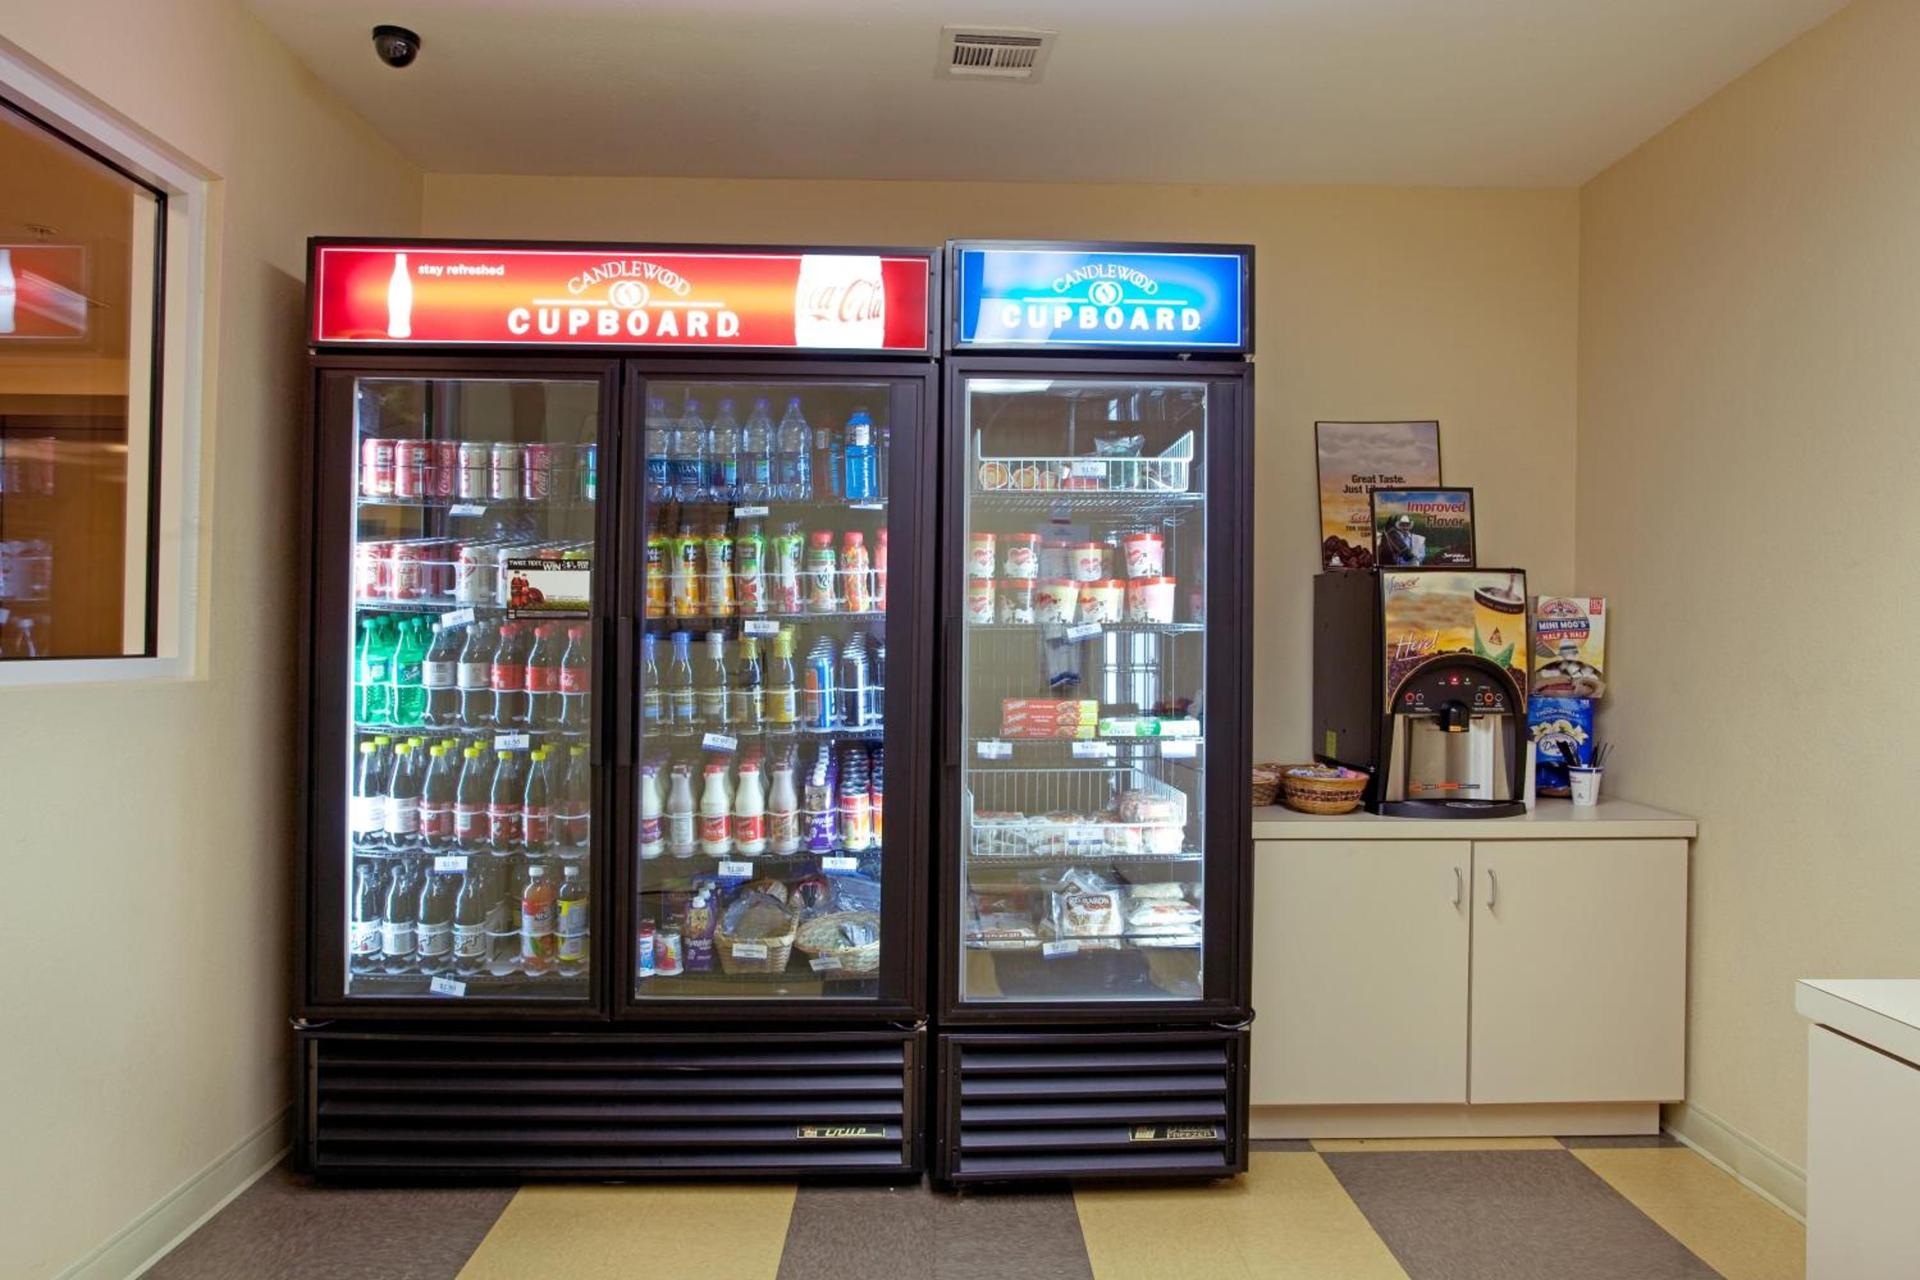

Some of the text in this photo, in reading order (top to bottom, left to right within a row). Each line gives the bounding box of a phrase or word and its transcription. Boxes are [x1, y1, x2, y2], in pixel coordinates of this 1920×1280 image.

[418, 263, 505, 276] stay refreshed
[567, 260, 691, 297] CANDLEWOOD
[1052, 264, 1159, 295] CANDLEWOOD
[507, 307, 740, 338] CUPBOARD
[1001, 303, 1202, 332] CUPBOARD
[1351, 474, 1377, 484] Great
[1343, 484, 1363, 494] Just
[1407, 501, 1466, 515] Improved
[1426, 514, 1465, 528] Flavor
[1539, 621, 1559, 631] MINI
[1543, 633, 1561, 641] HALF
[1570, 630, 1588, 639] HALF
[1395, 629, 1440, 660] Here!
